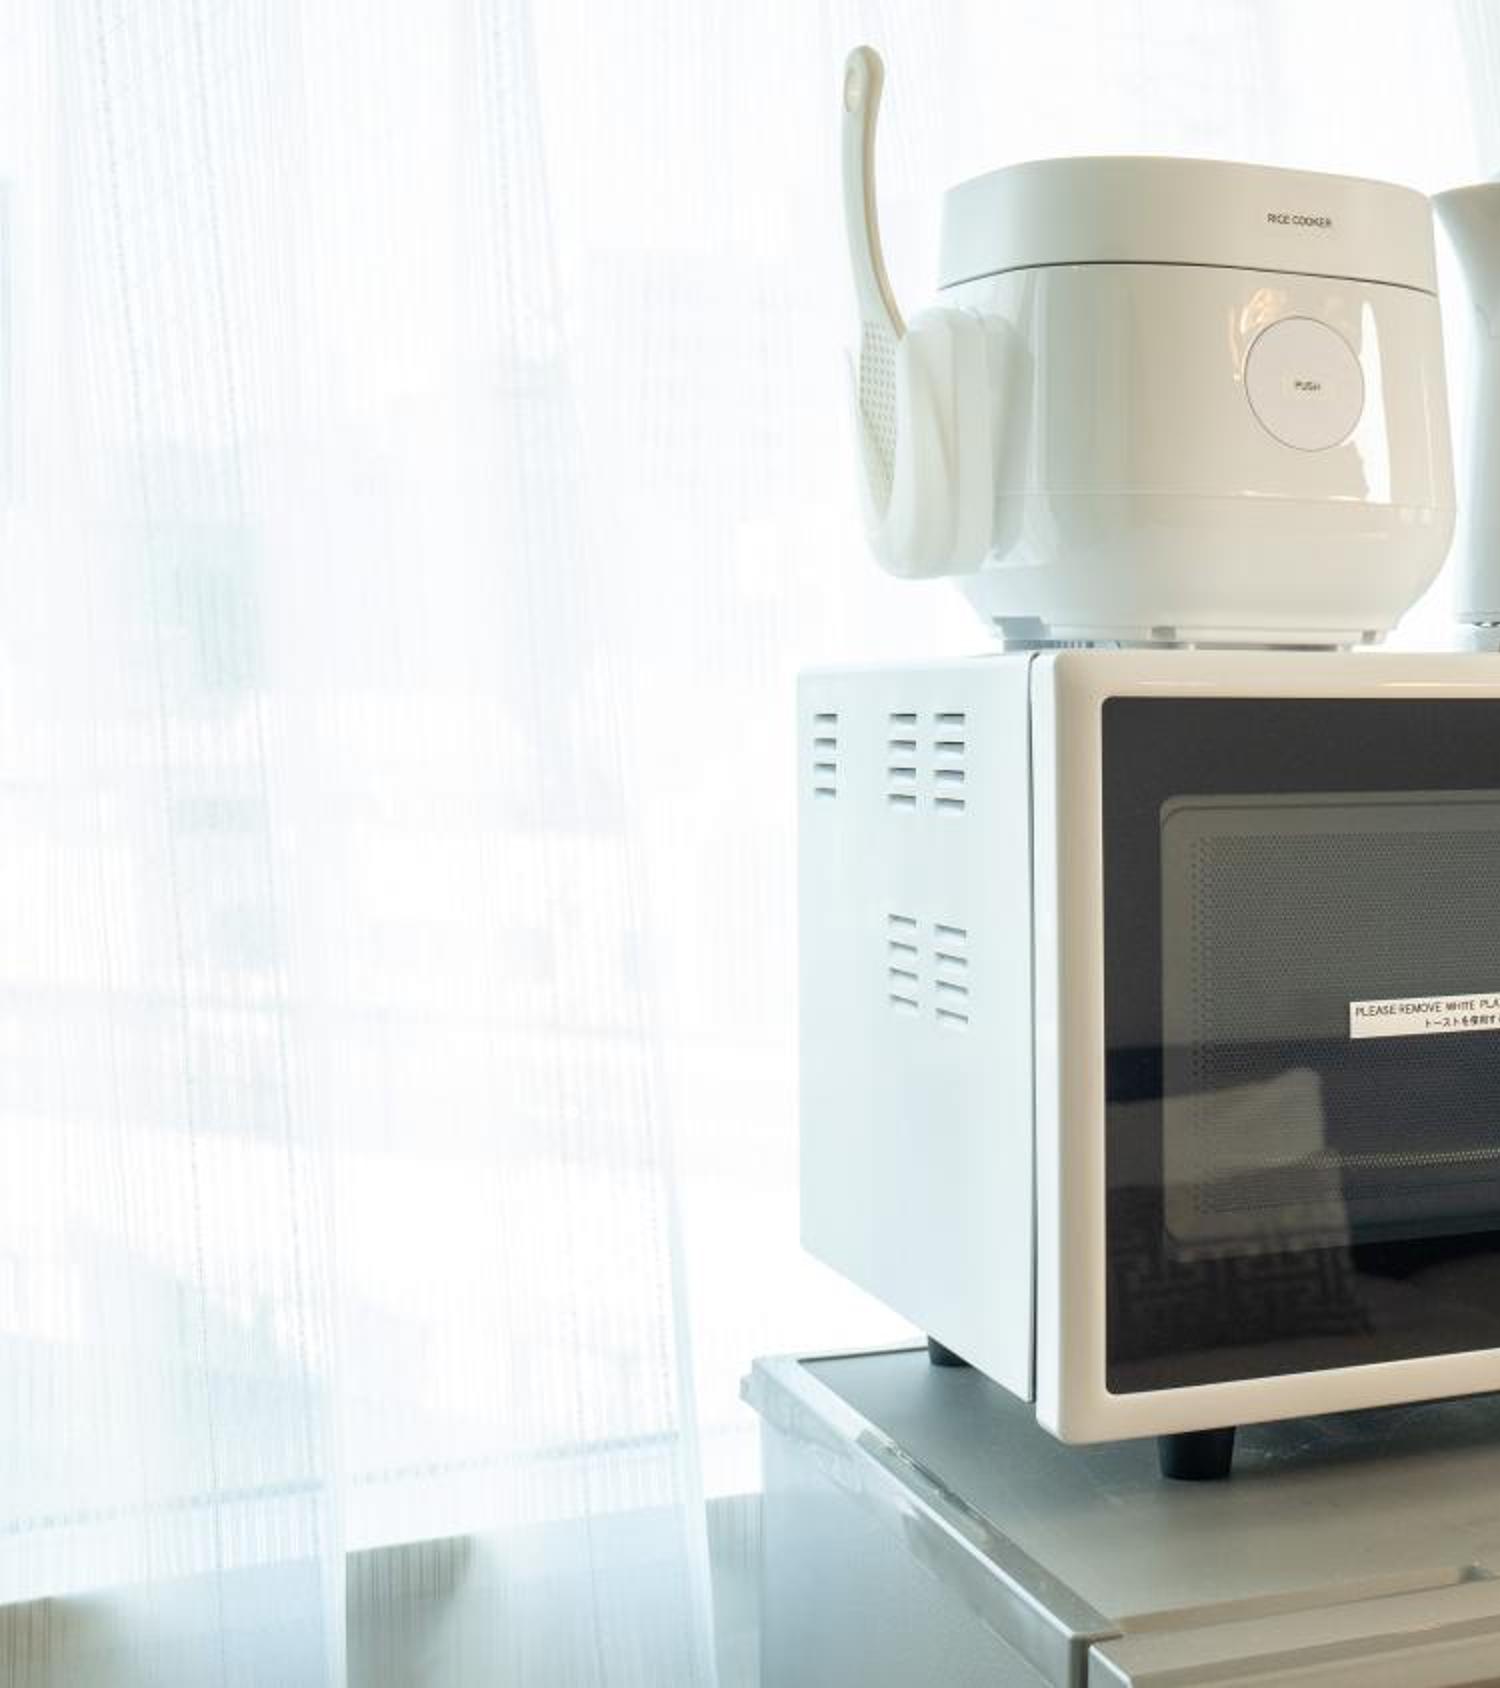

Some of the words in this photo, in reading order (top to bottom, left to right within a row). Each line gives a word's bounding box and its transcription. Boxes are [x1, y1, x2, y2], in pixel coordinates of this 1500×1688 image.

[1267, 213, 1290, 225] RICE
[1292, 215, 1332, 228] COOKER
[1296, 380, 1320, 391] PUSH
[1355, 1005, 1396, 1017] PLEASE
[1399, 1001, 1442, 1015] REMOVE
[1445, 1000, 1475, 1012] WHITE
